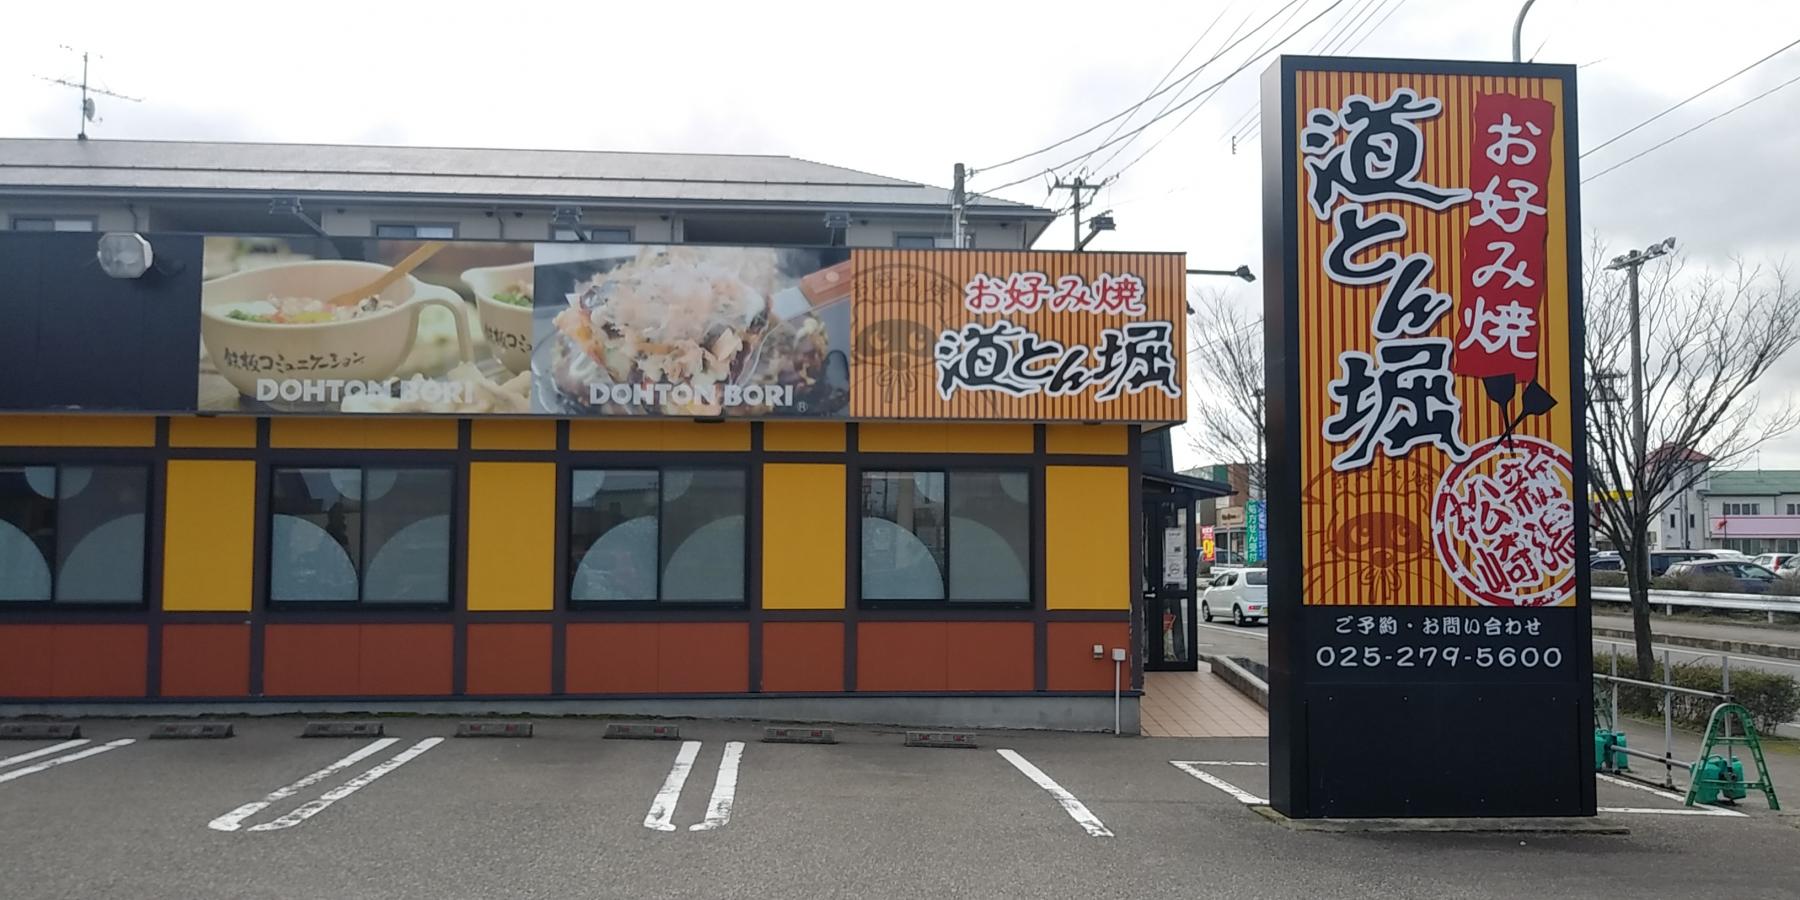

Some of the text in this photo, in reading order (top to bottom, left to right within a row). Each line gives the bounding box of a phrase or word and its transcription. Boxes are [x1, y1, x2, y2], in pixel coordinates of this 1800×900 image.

[1459, 112, 1548, 359] お好み焼
[965, 272, 1147, 316] お好み焼
[1301, 88, 1473, 472] 道とん堀
[934, 320, 1182, 403] 道とん堀
[256, 378, 394, 403] DOHTON
[589, 382, 794, 407] DOHTON BORI
[1335, 615, 1542, 636] ご予約・お問い合わせ
[1315, 645, 1563, 668] 025-279-5600
